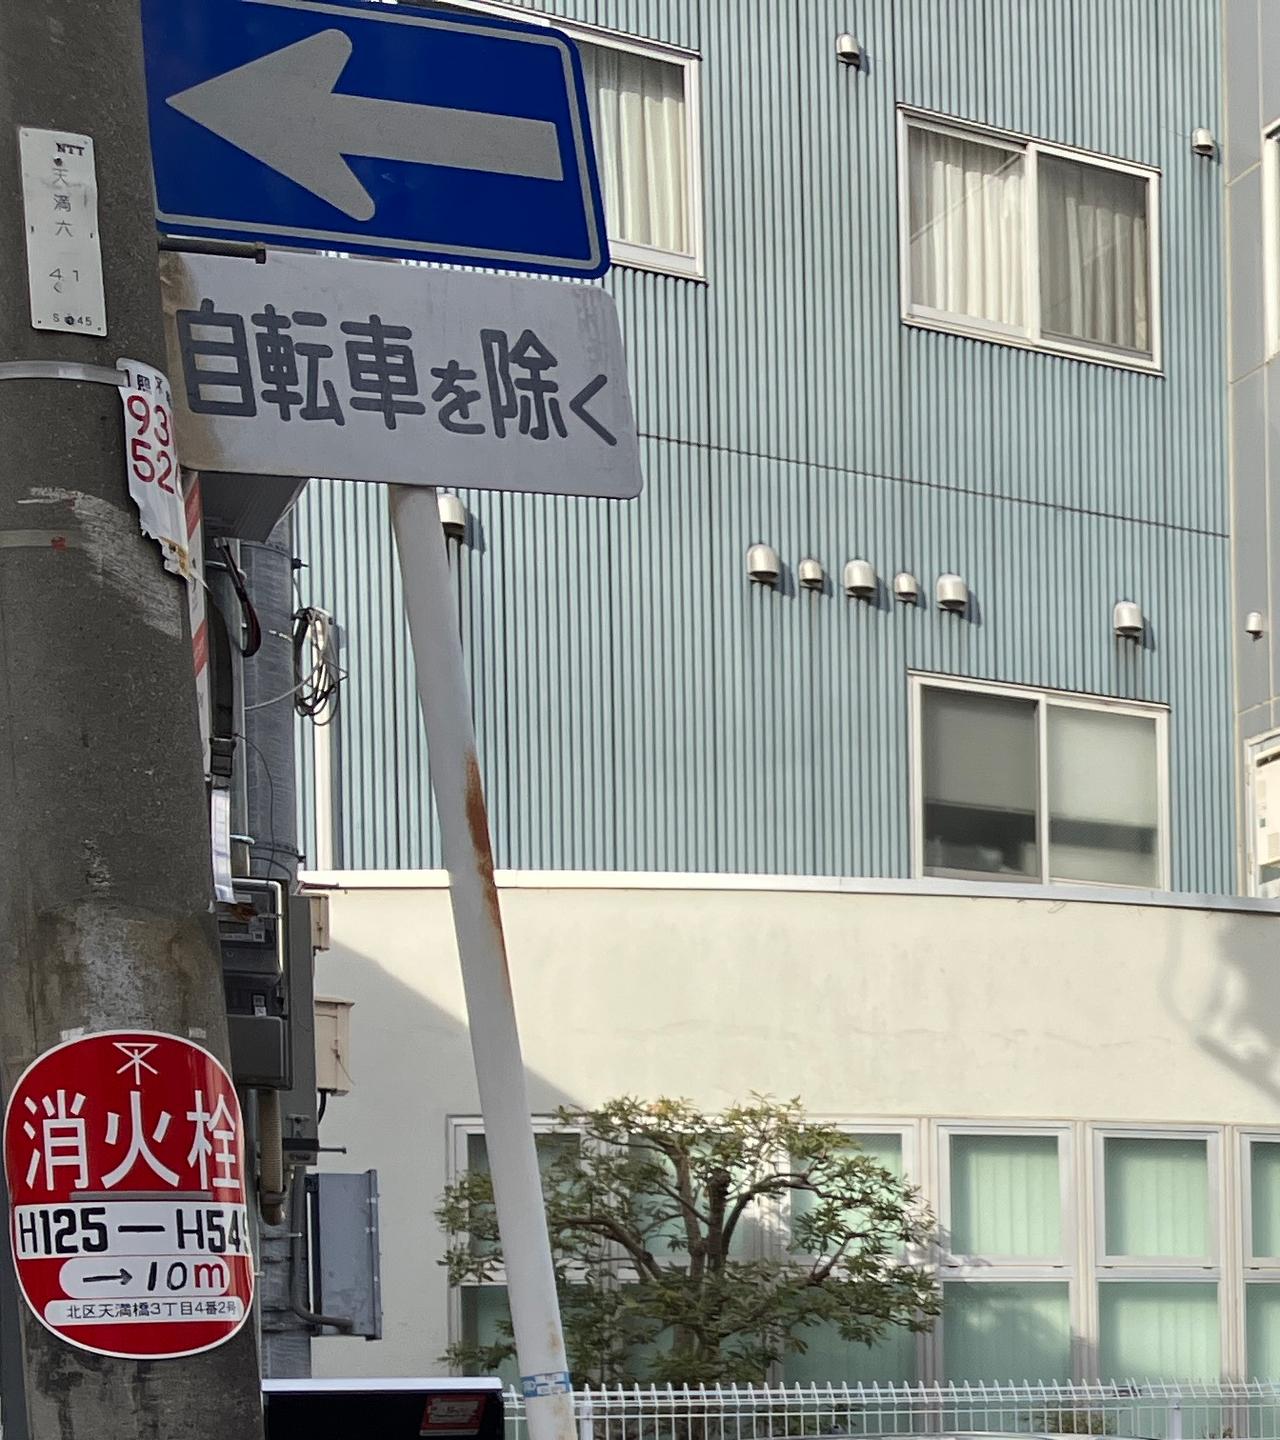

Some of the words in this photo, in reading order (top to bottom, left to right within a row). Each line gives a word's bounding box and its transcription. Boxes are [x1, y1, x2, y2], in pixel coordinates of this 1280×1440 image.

[56, 143, 85, 156] NTT
[176, 298, 618, 447] 自転車を除く
[127, 395, 170, 448] 93
[131, 437, 175, 495] 52
[24, 1089, 241, 1191] 消火栓
[147, 1261, 225, 1291] 10m
